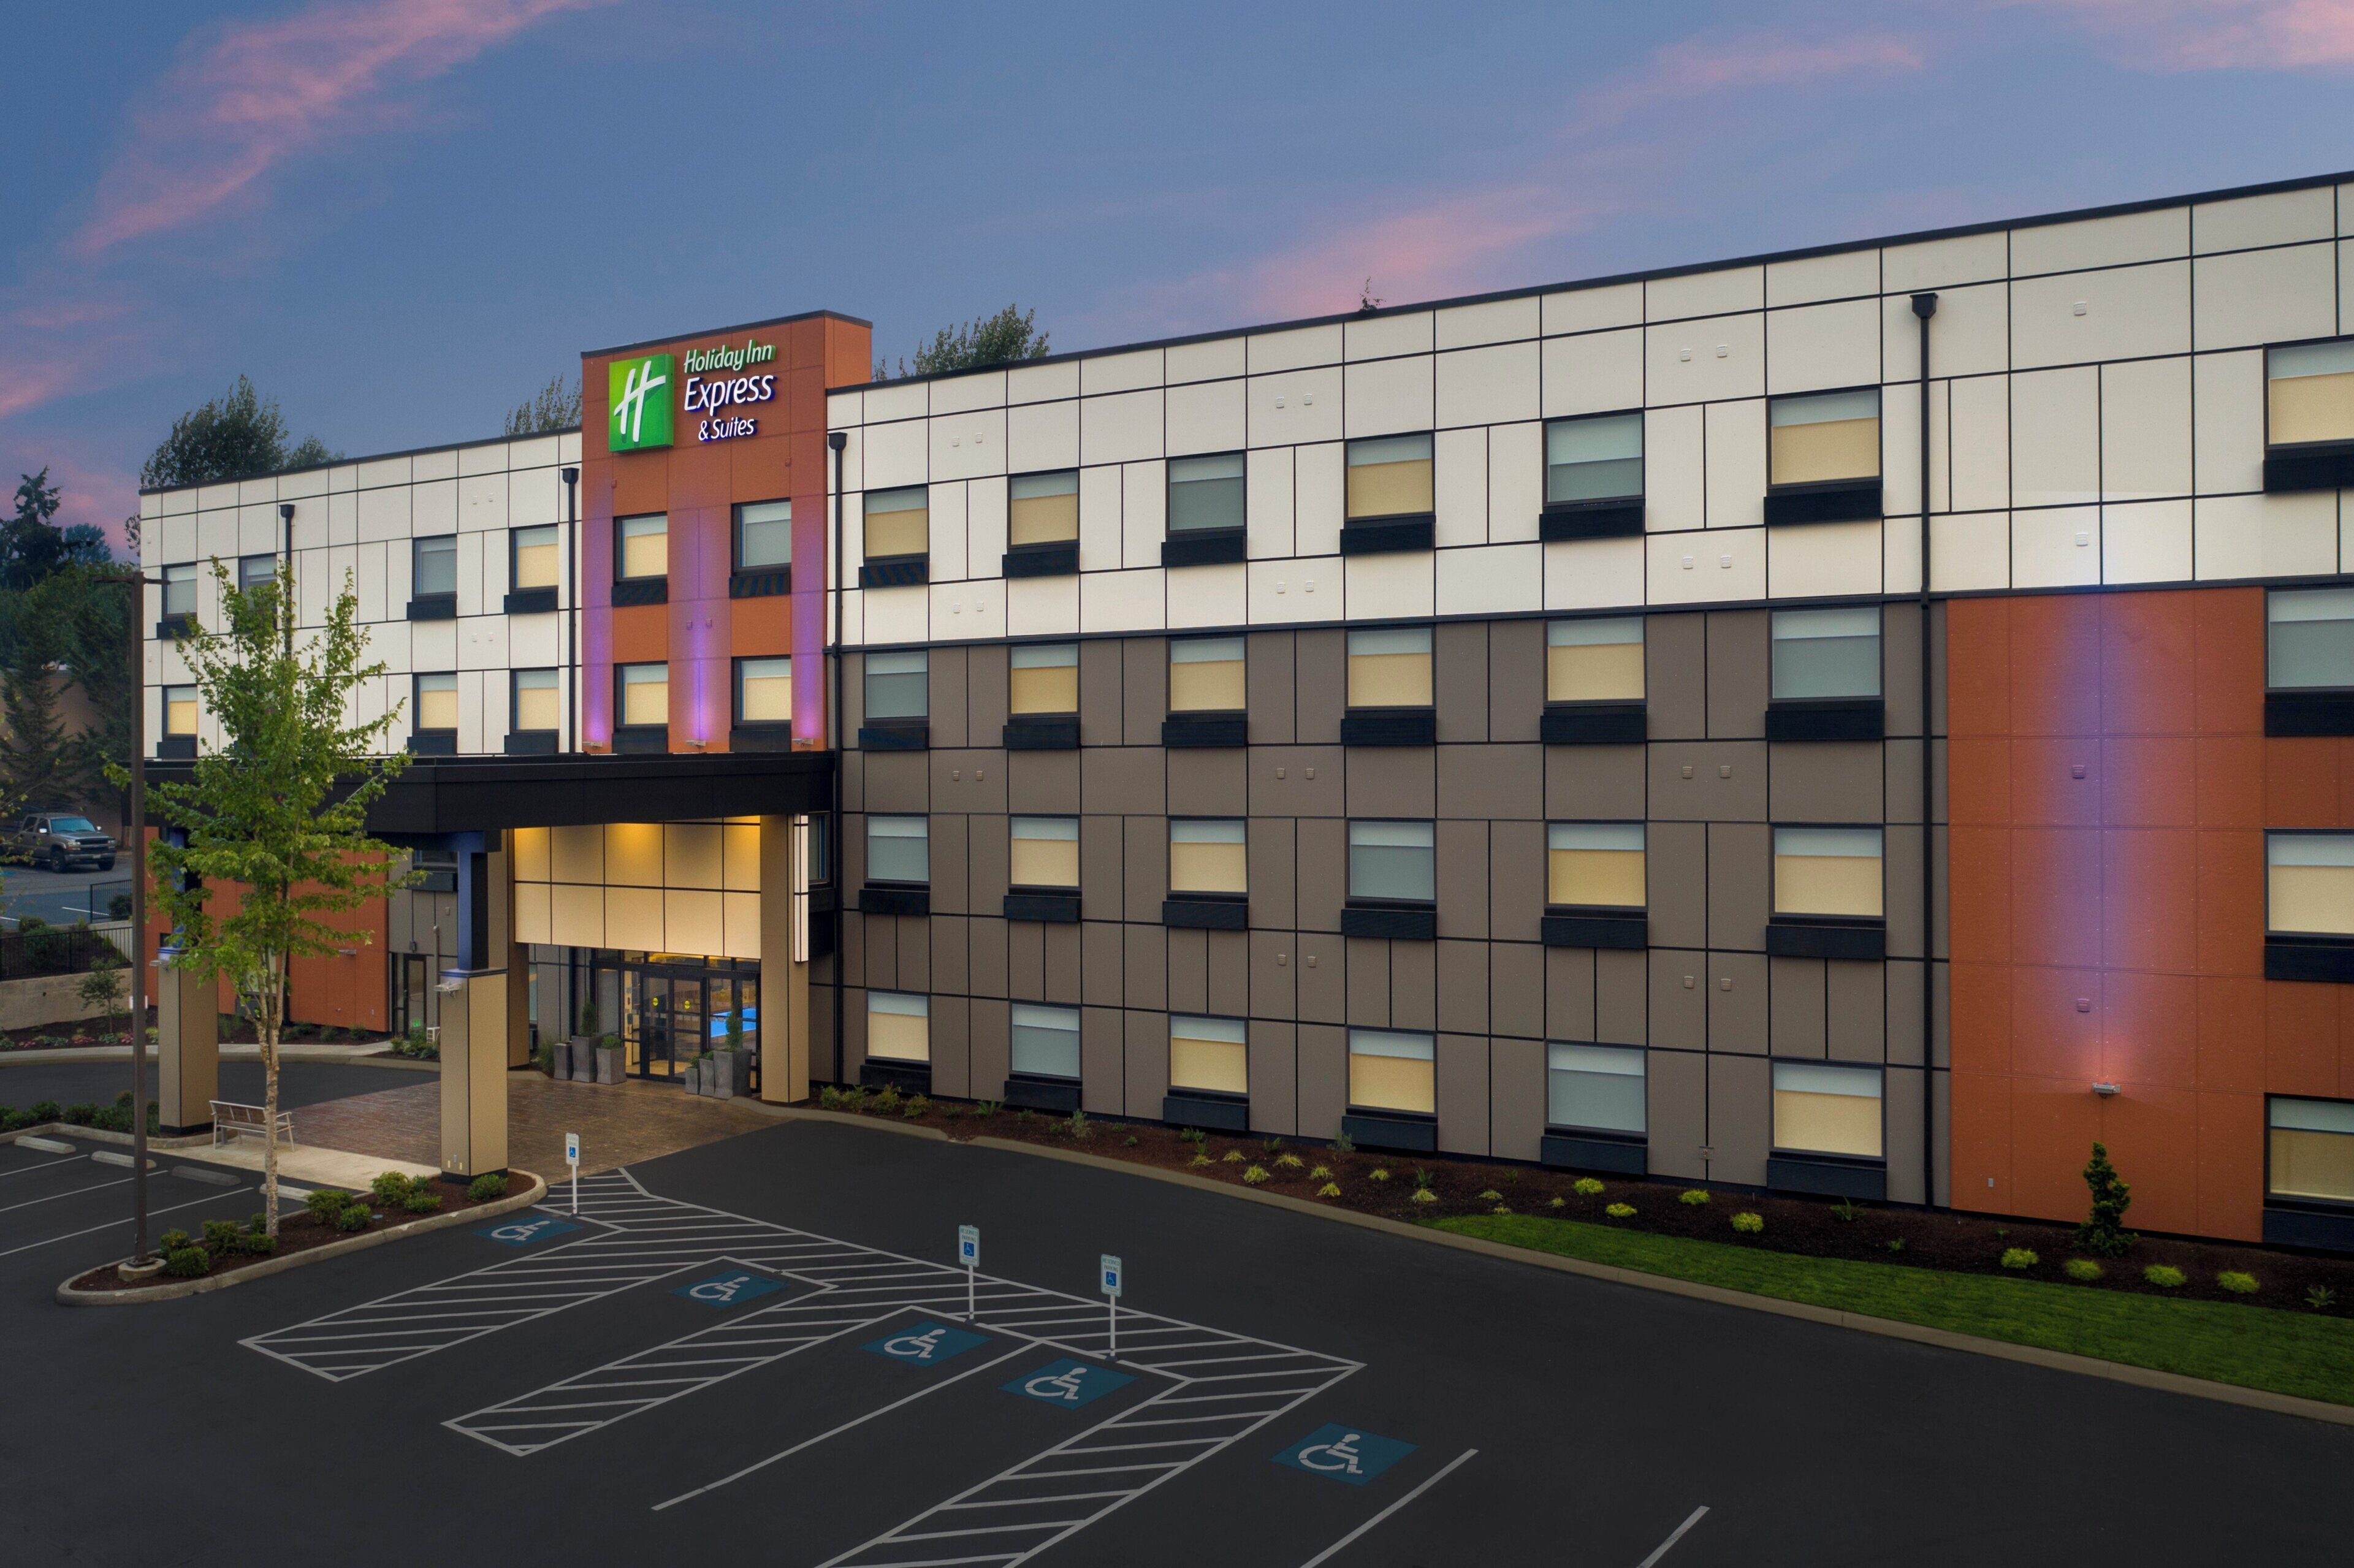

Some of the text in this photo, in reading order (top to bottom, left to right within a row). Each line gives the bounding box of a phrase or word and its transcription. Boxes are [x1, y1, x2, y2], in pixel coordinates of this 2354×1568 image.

[684, 340, 774, 373] Holiday Inn
[684, 375, 774, 416] Express
[698, 417, 755, 441] & Suites
[1103, 1264, 1119, 1273] PARKING
